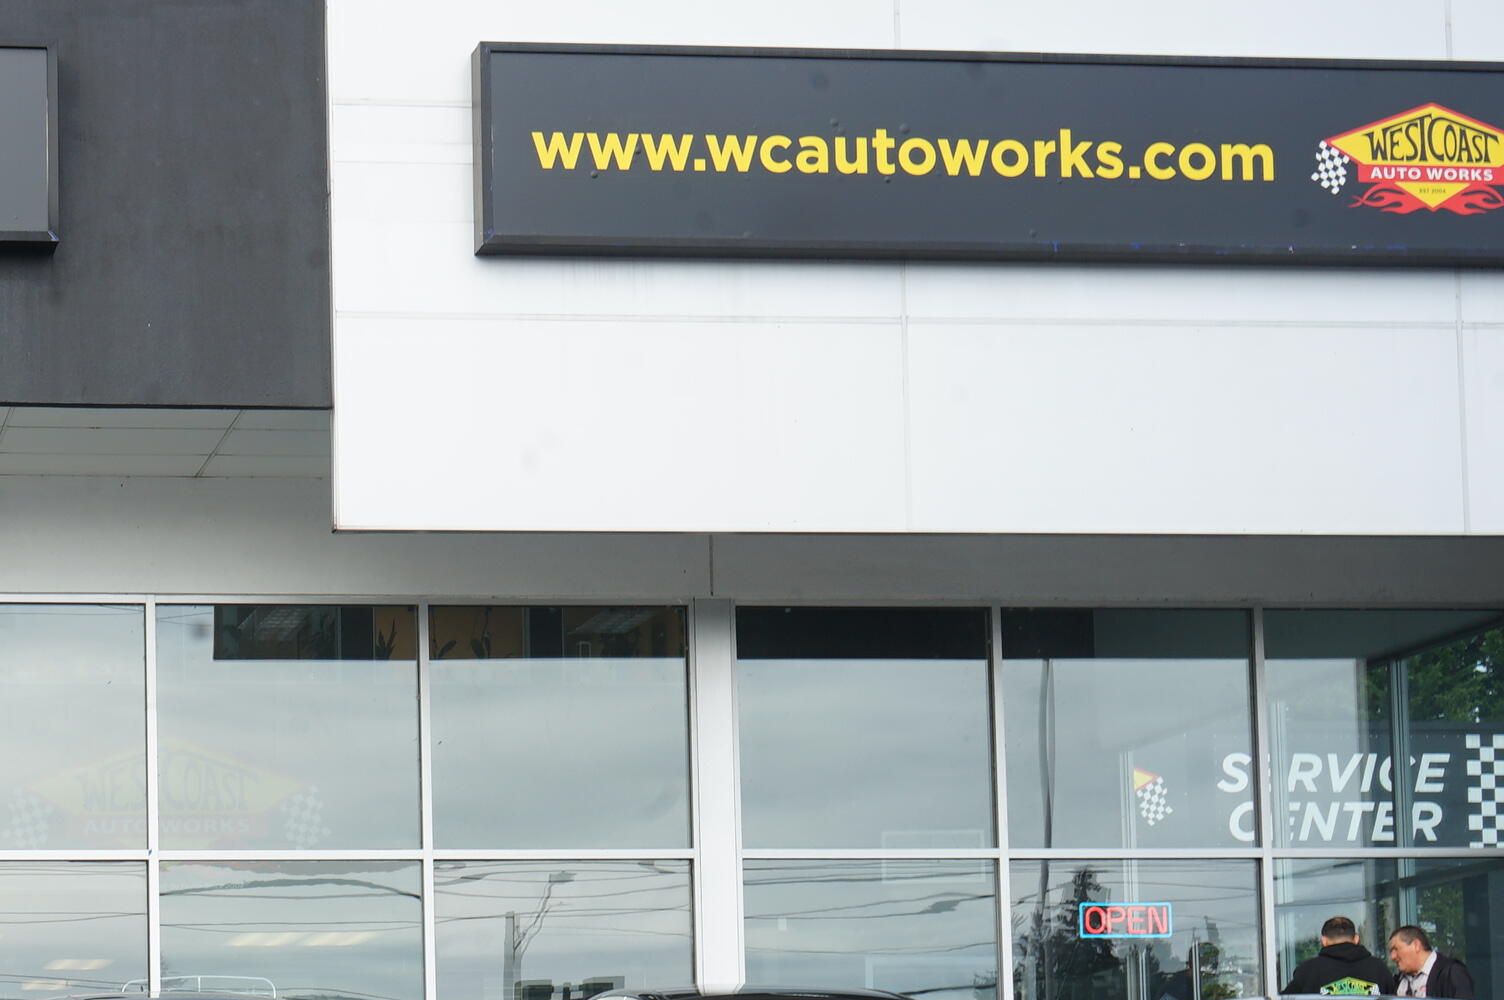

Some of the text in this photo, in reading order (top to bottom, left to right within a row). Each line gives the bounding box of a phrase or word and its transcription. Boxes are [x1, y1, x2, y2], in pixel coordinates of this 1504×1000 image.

[531, 129, 1275, 182] www.wcautoworks.com
[1371, 167, 1494, 181] AUTO WORKS
[1216, 752, 1451, 793] SRVIE
[1229, 801, 1443, 842] CNTER
[1084, 906, 1167, 934] OPEN
